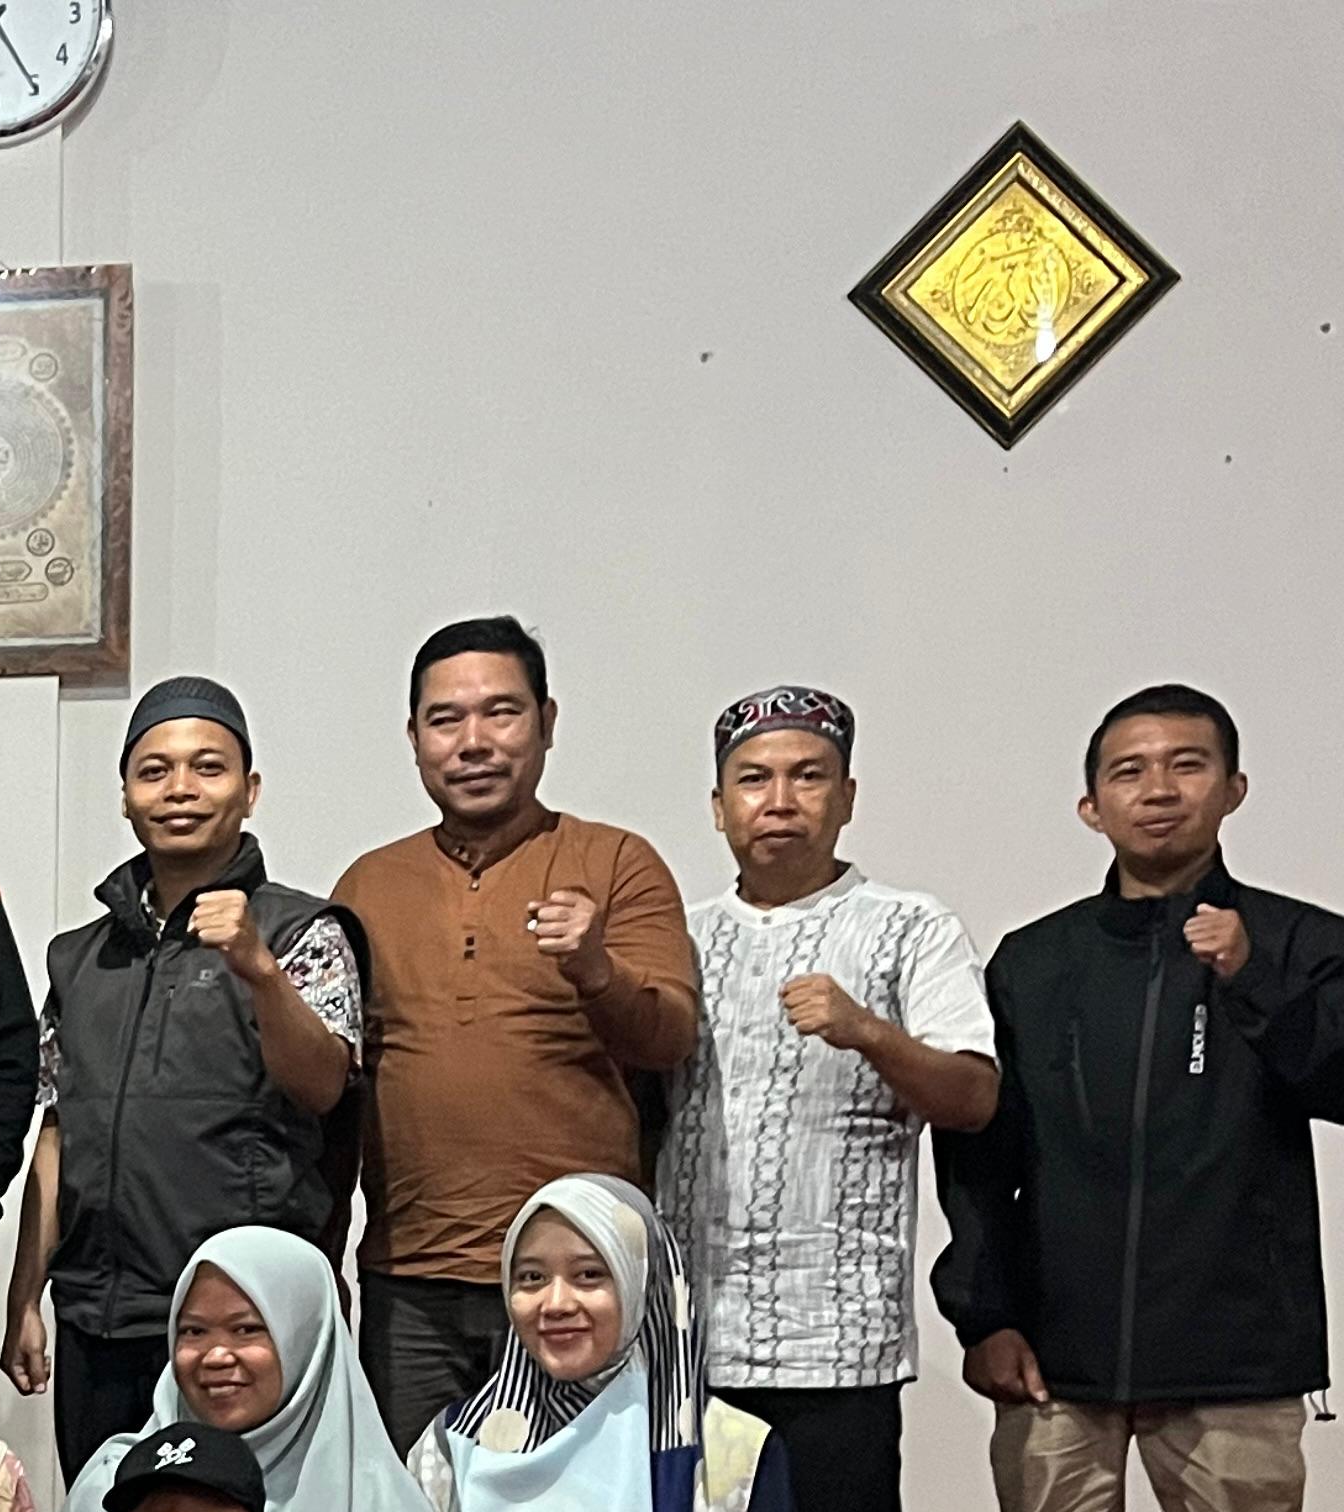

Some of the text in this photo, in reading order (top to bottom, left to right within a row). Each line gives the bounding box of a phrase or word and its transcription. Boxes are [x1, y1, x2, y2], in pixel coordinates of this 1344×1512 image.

[68, 2, 82, 24] 3
[55, 43, 69, 65] 4
[27, 74, 40, 96] 5
